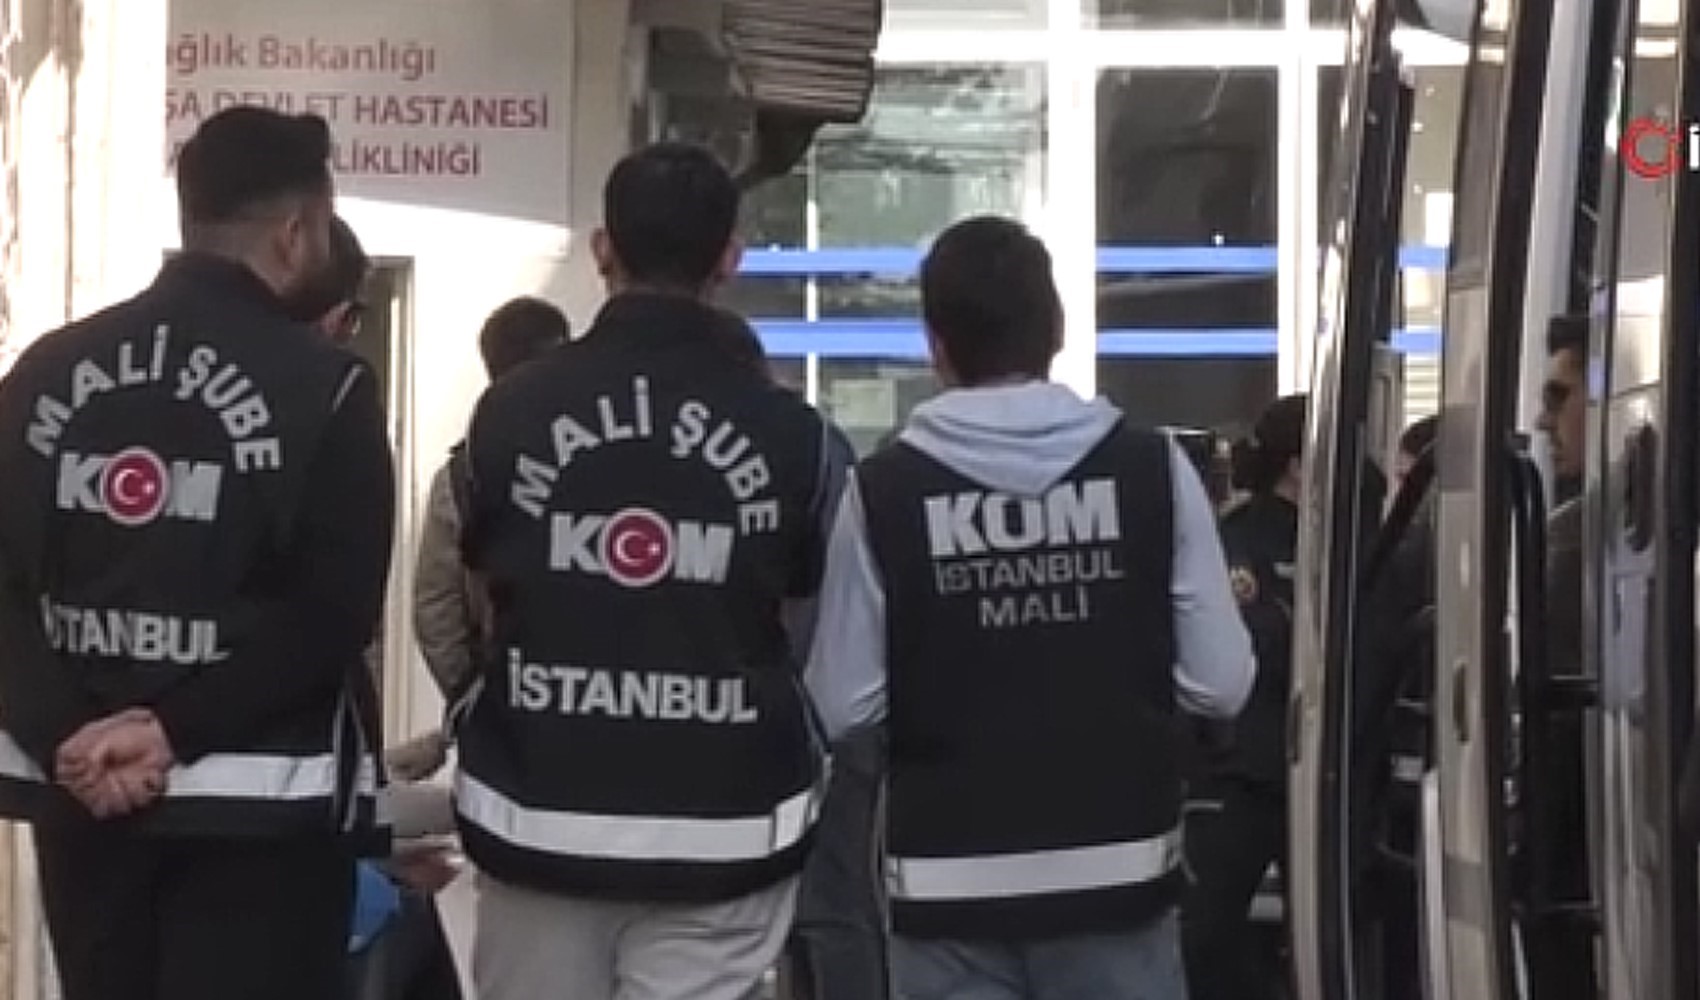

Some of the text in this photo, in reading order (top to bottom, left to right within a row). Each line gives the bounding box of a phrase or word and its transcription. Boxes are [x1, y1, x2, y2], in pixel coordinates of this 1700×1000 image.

[258, 35, 435, 81] Bakanlığı
[355, 93, 548, 130] HASTANESİ
[26, 324, 281, 473] MALİ ŞUBE
[511, 375, 779, 536] MALİ ŞUBE
[549, 507, 735, 588] KOM
[924, 478, 1120, 556] KOM
[508, 648, 758, 723] İSTANBUL
